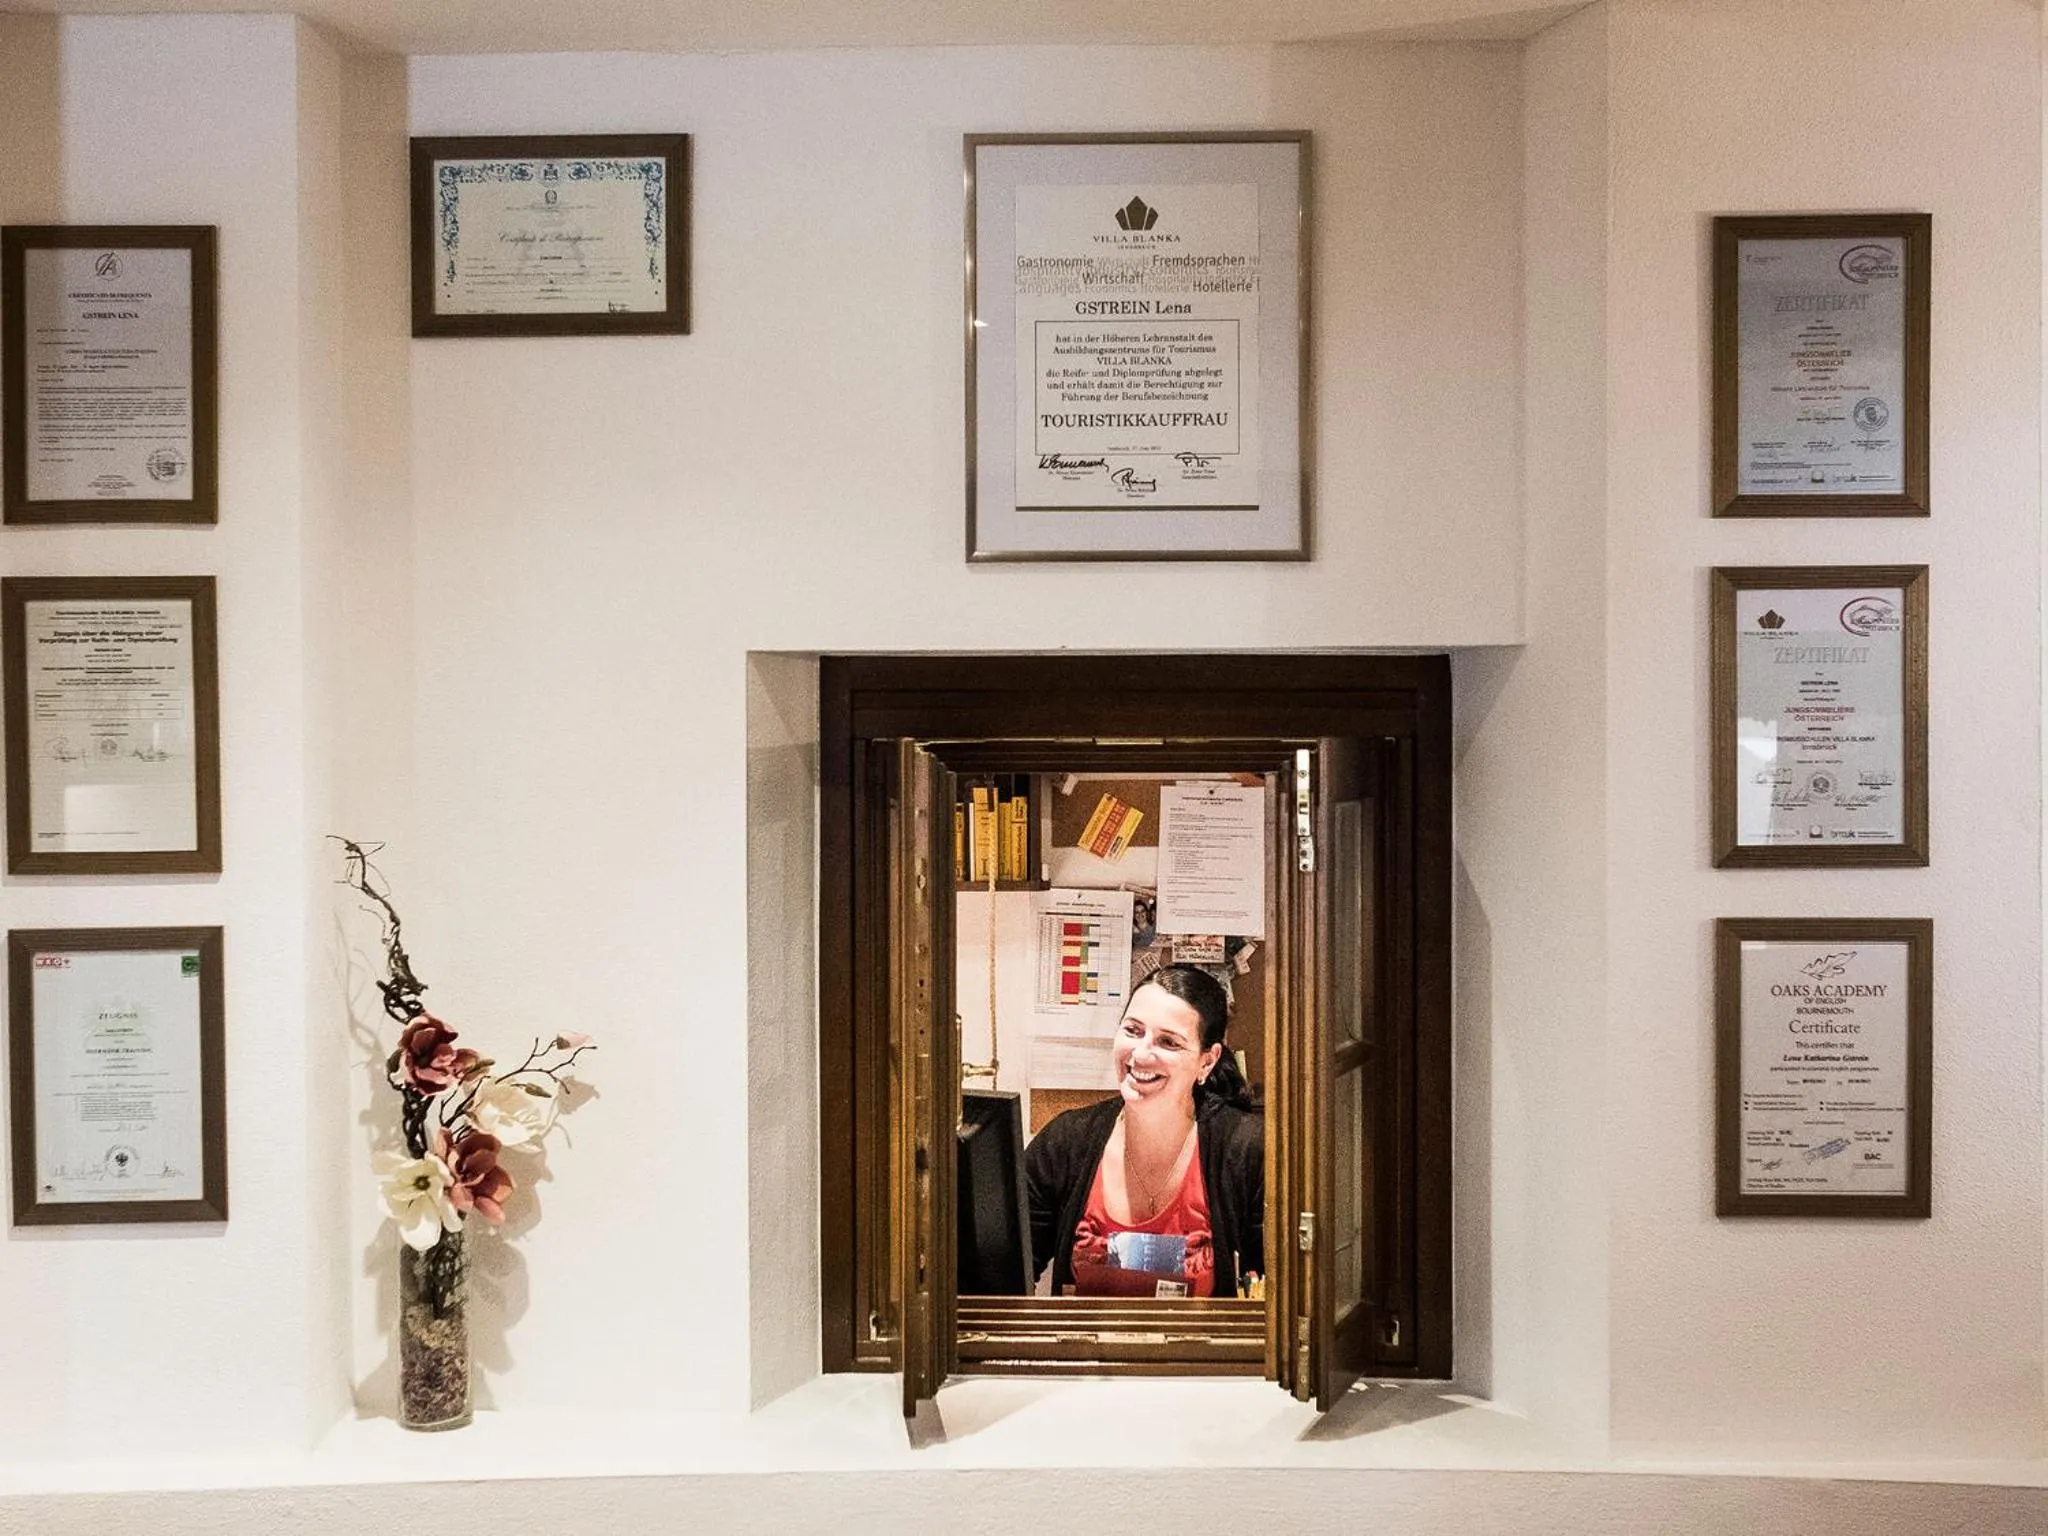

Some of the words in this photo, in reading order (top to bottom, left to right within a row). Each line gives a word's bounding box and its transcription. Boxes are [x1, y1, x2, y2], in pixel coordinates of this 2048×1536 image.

[1093, 235, 1129, 243] VILLA
[1132, 235, 1181, 243] BLANKA
[1016, 253, 1094, 269] Gastronomie
[1153, 252, 1245, 269] Fremdsprachen
[1082, 271, 1144, 285] Wirtschaft
[1193, 277, 1253, 294] Hotellerie
[1075, 301, 1151, 315] GSTREIN
[1155, 301, 1192, 315] Lena
[1056, 333, 1070, 343] hat
[1073, 333, 1082, 343] in
[1085, 333, 1099, 343] der
[1102, 333, 1141, 343] Höheren
[1143, 333, 1195, 343] Lehranstalt
[1197, 333, 1213, 343] des
[1053, 346, 1150, 357] Ausbildungszentrums
[1152, 346, 1165, 354] für
[1168, 346, 1216, 354] Tourismus
[1096, 356, 1128, 365] VILLA
[1130, 356, 1172, 365] BLANKA
[1046, 368, 1060, 379] die
[1062, 368, 1090, 379] Reife-
[1092, 368, 1110, 379] und
[1112, 368, 1182, 379] Diplomprüfung
[1184, 368, 1223, 379] abgelegt
[1047, 380, 1064, 391] und
[1067, 380, 1095, 391] erhält
[1097, 380, 1124, 391] damit
[1126, 380, 1141, 391] die
[1143, 380, 1205, 391] Berechtigung
[1207, 380, 1223, 391] zur
[1061, 392, 1102, 402] Führung
[1104, 392, 1119, 402] der
[1121, 392, 1209, 402] Berufsbezeichnung
[1041, 412, 1229, 428] TOURISTIKKAUFFRAU
[1770, 984, 1810, 998] OAKS
[1813, 984, 1888, 998] ACADEMY
[1796, 1007, 1855, 1015] BOURNEMOUTH
[1788, 1019, 1861, 1035] Certificate
[1795, 1041, 1809, 1050] This
[1810, 1041, 1838, 1050] certifies
[1839, 1041, 1855, 1050] that
[1783, 1054, 1801, 1062] Lena
[1864, 1153, 1881, 1161] BAC
